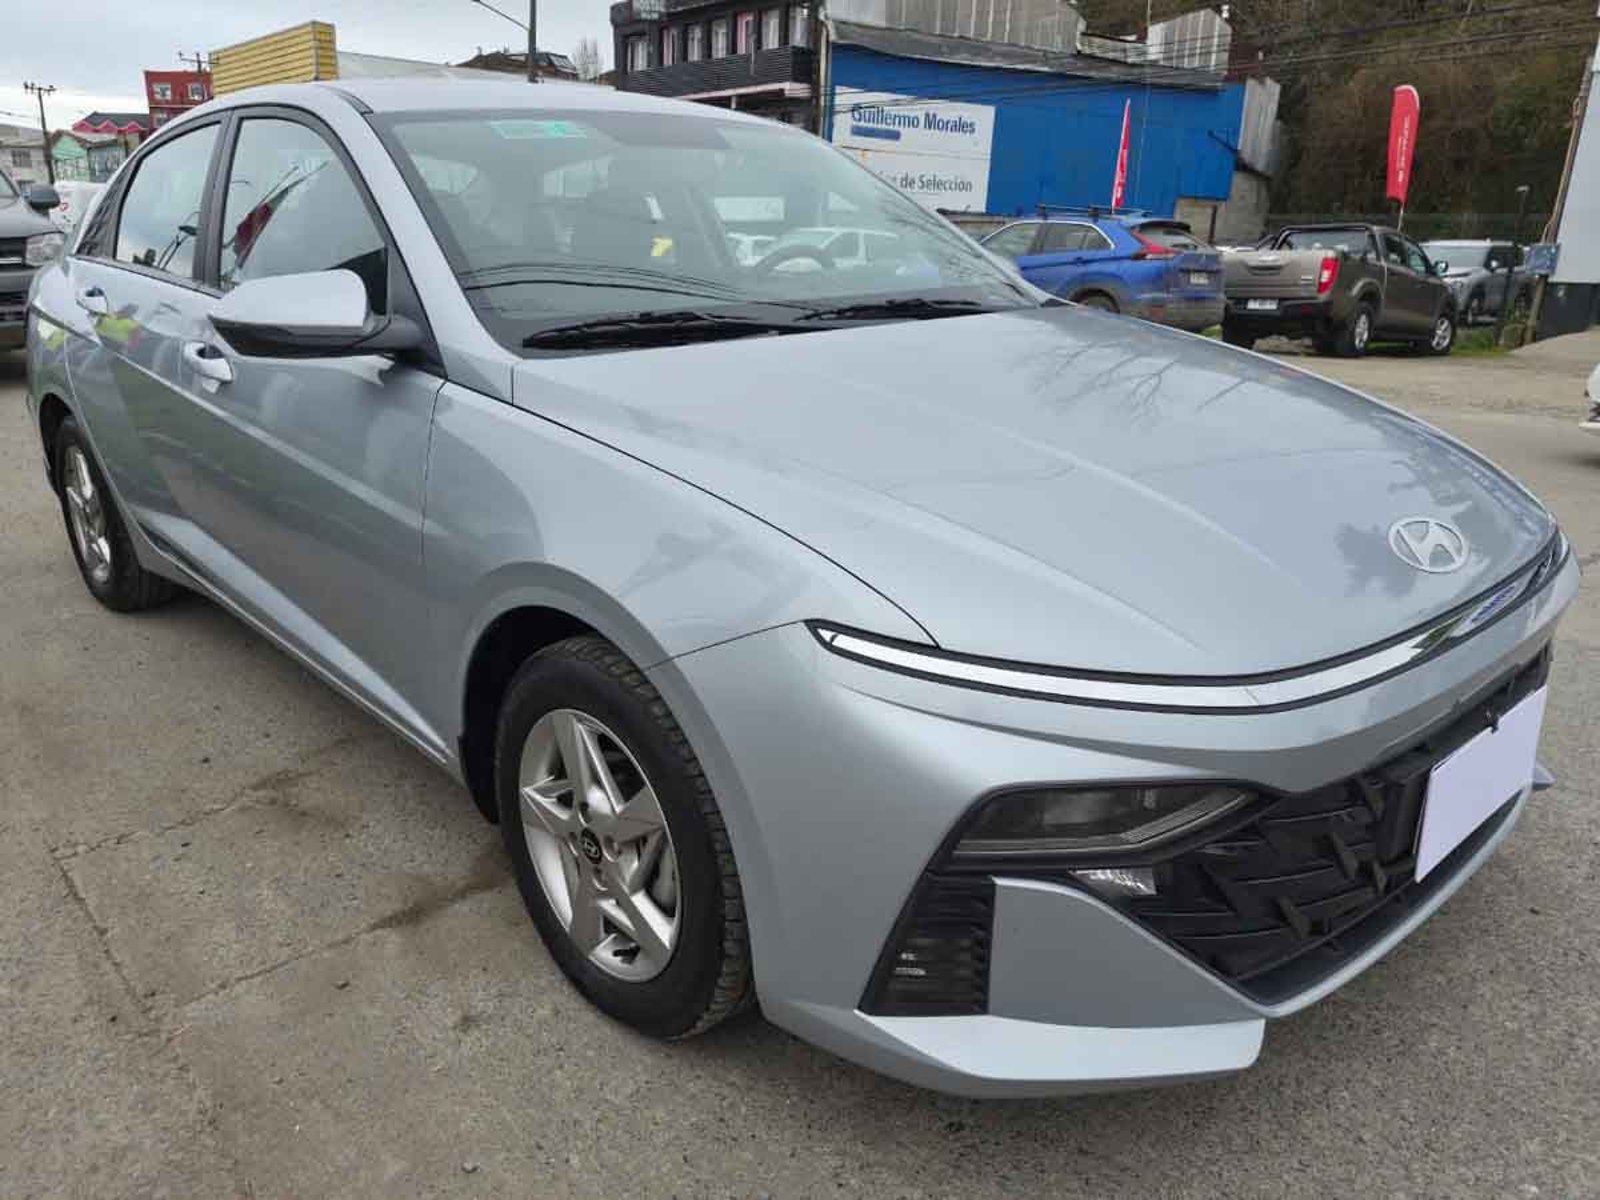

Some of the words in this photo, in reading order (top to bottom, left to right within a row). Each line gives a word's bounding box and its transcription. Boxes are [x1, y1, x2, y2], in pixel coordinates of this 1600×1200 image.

[852, 105, 919, 128] Guillermo
[923, 112, 976, 134] Morales
[900, 171, 916, 189] de
